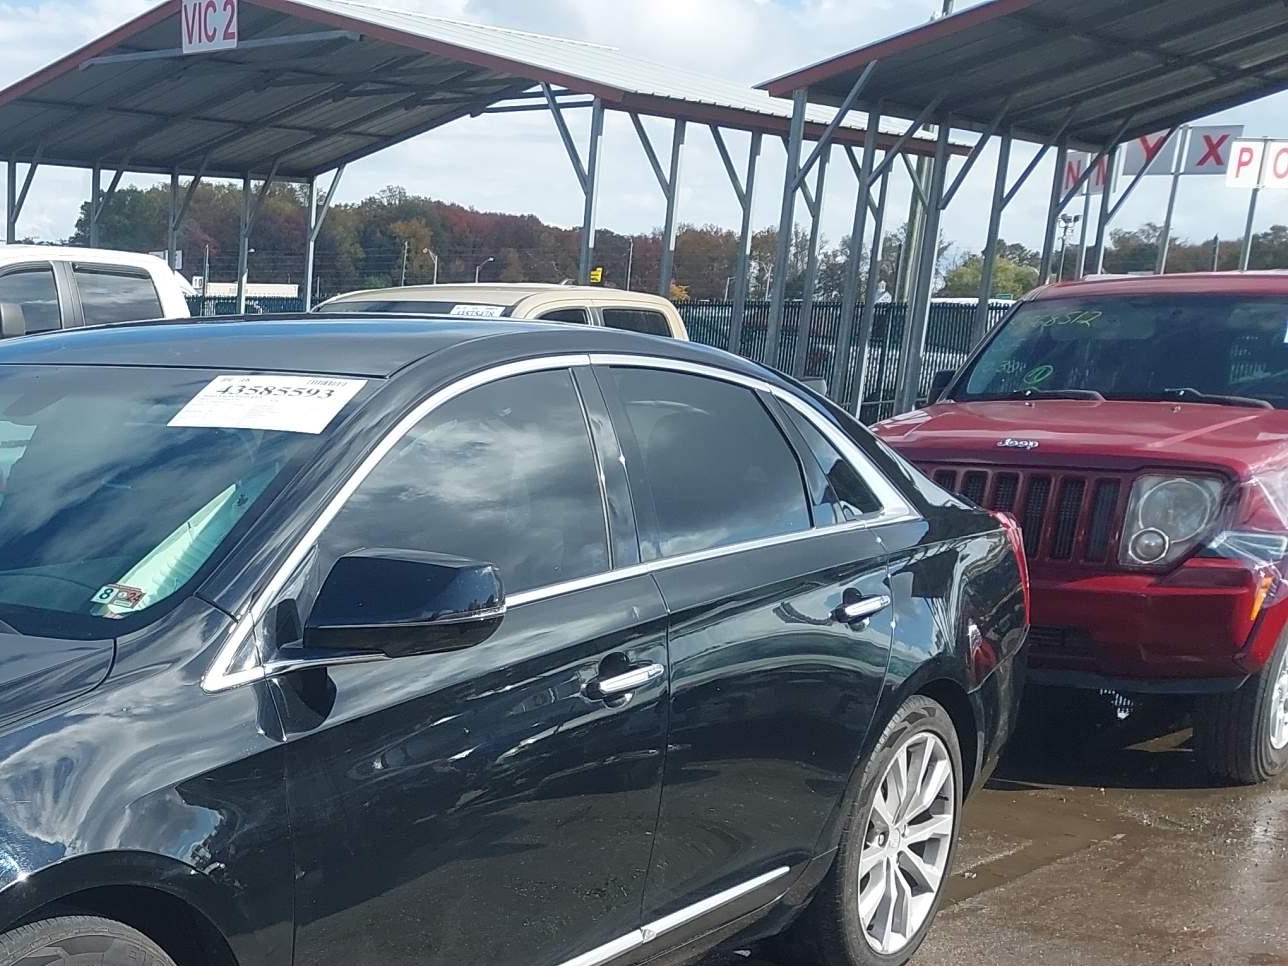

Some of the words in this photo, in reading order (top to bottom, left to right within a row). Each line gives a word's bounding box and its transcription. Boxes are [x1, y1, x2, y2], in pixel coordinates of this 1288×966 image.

[184, 0, 217, 44] VIC
[223, 0, 235, 40] 2
[1196, 134, 1230, 166] X
[1235, 147, 1253, 178] P
[216, 383, 335, 399] 43585593
[996, 438, 1040, 450] Jeep
[98, 588, 114, 600] 8
